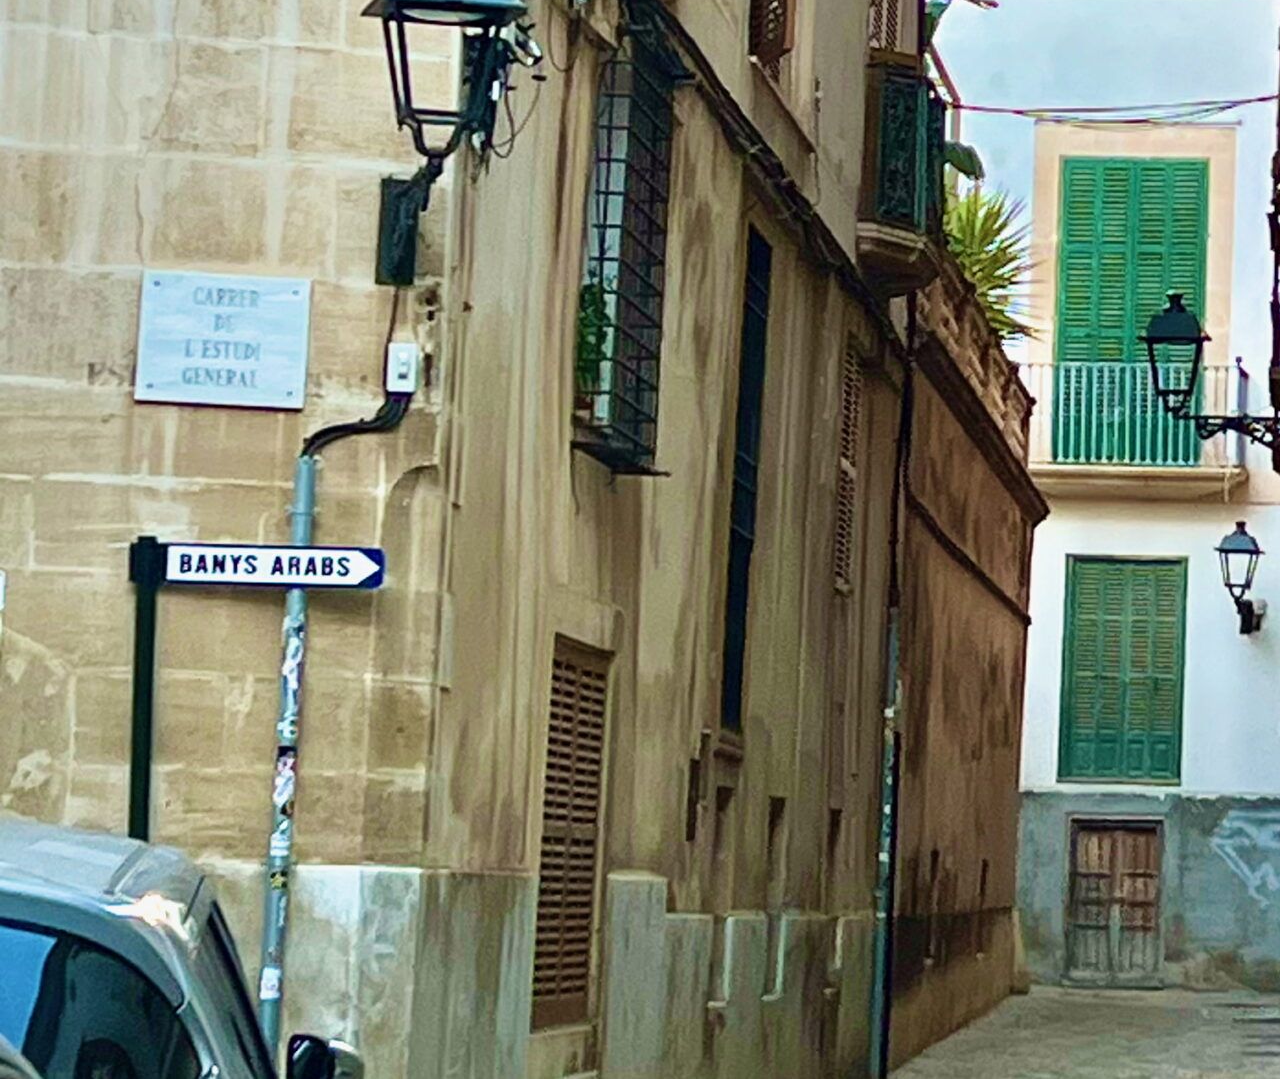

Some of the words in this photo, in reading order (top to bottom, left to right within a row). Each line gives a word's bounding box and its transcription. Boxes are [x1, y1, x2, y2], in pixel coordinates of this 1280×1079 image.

[193, 286, 260, 308] CARRER
[214, 313, 235, 333] DE
[182, 366, 258, 390] GENERAL
[179, 553, 259, 575] BANYS
[270, 555, 351, 578] ARABS
